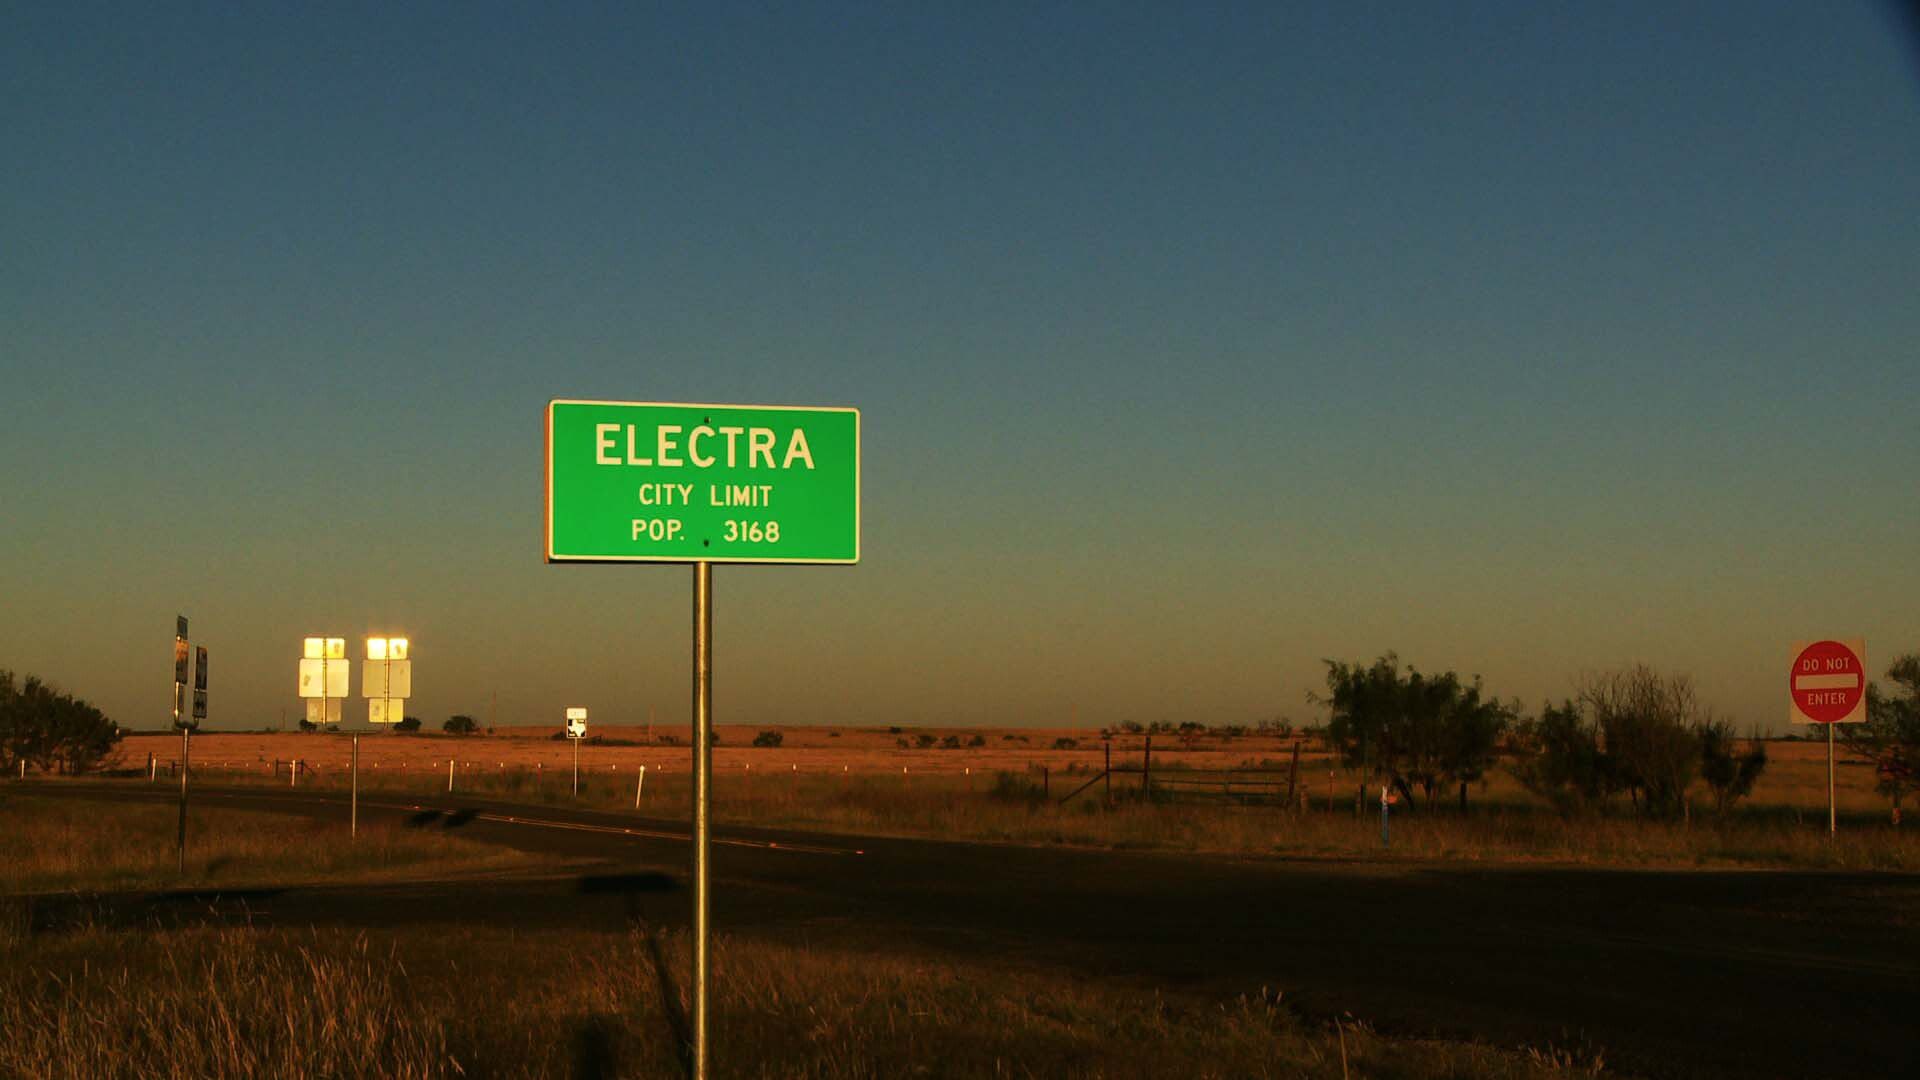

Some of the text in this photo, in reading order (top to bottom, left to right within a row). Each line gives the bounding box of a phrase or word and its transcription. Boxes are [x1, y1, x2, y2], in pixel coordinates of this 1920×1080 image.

[597, 423, 815, 469] ELECTRA
[639, 483, 772, 507] CITY LIMIT
[632, 518, 780, 543] POP. 3168
[1803, 657, 1850, 671] DO NOT
[1808, 692, 1847, 705] ENTER
